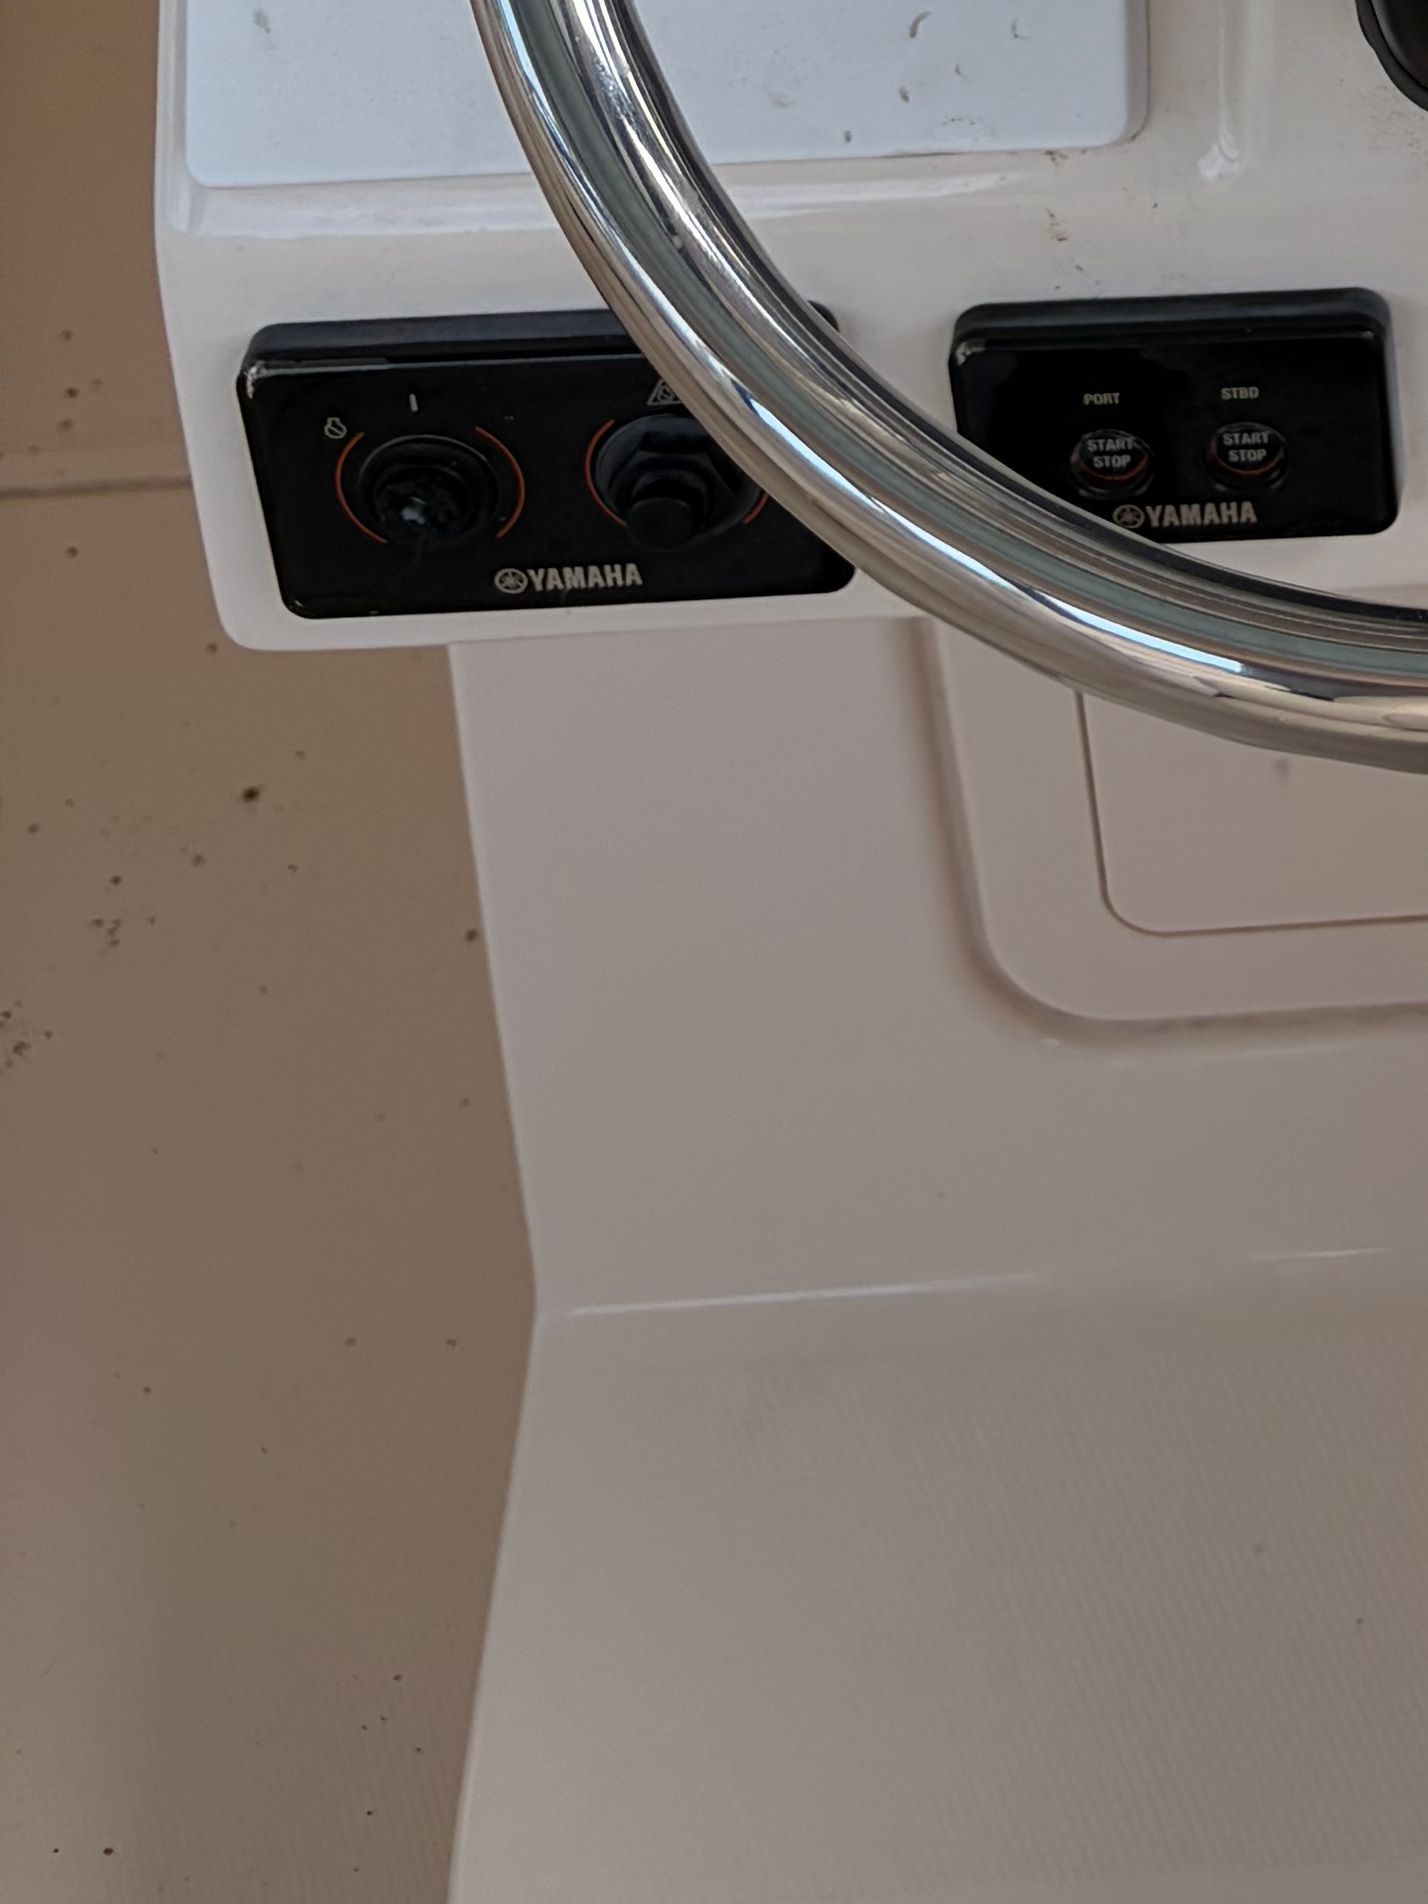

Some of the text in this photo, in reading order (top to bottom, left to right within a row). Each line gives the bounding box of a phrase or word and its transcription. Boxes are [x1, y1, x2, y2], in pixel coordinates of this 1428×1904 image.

[1082, 392, 1121, 406] PORT
[1220, 386, 1260, 401] STBD
[1086, 438, 1134, 452] START
[1222, 431, 1271, 446] START
[1092, 454, 1132, 469] STOP
[1228, 448, 1268, 463] STOP
[1145, 500, 1258, 528] YAMAHA
[526, 561, 642, 592] YAMAHA
